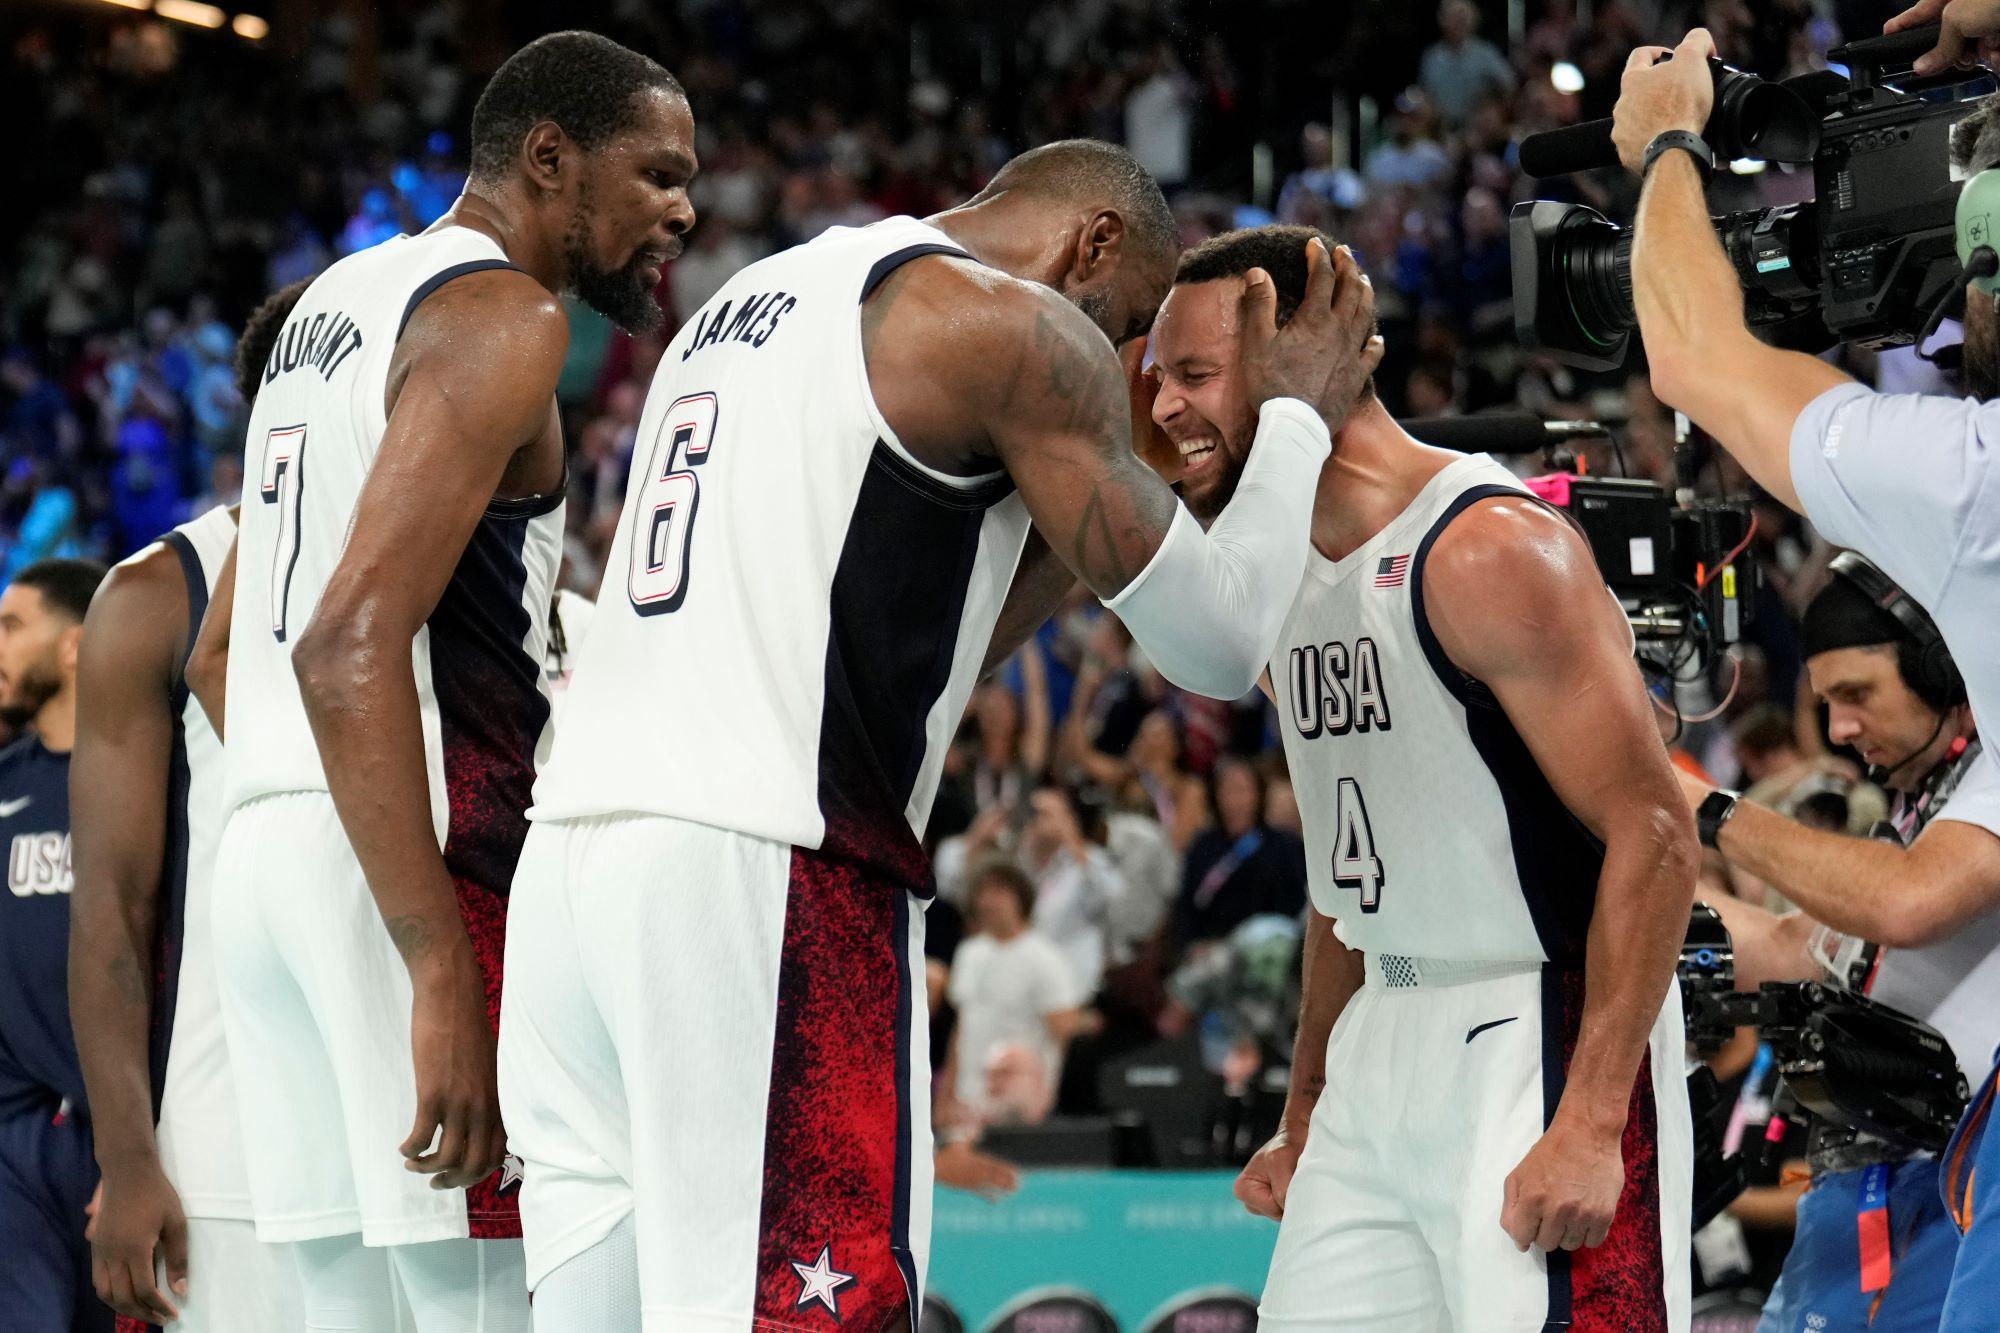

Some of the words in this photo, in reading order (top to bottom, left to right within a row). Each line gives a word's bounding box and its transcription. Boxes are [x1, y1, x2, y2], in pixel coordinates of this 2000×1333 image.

[265, 311, 362, 385] DURANT
[682, 291, 797, 362] JAMES
[261, 423, 307, 642] 7
[628, 391, 718, 617] 6
[1290, 637, 1391, 739] USA
[1332, 777, 1385, 913] 4
